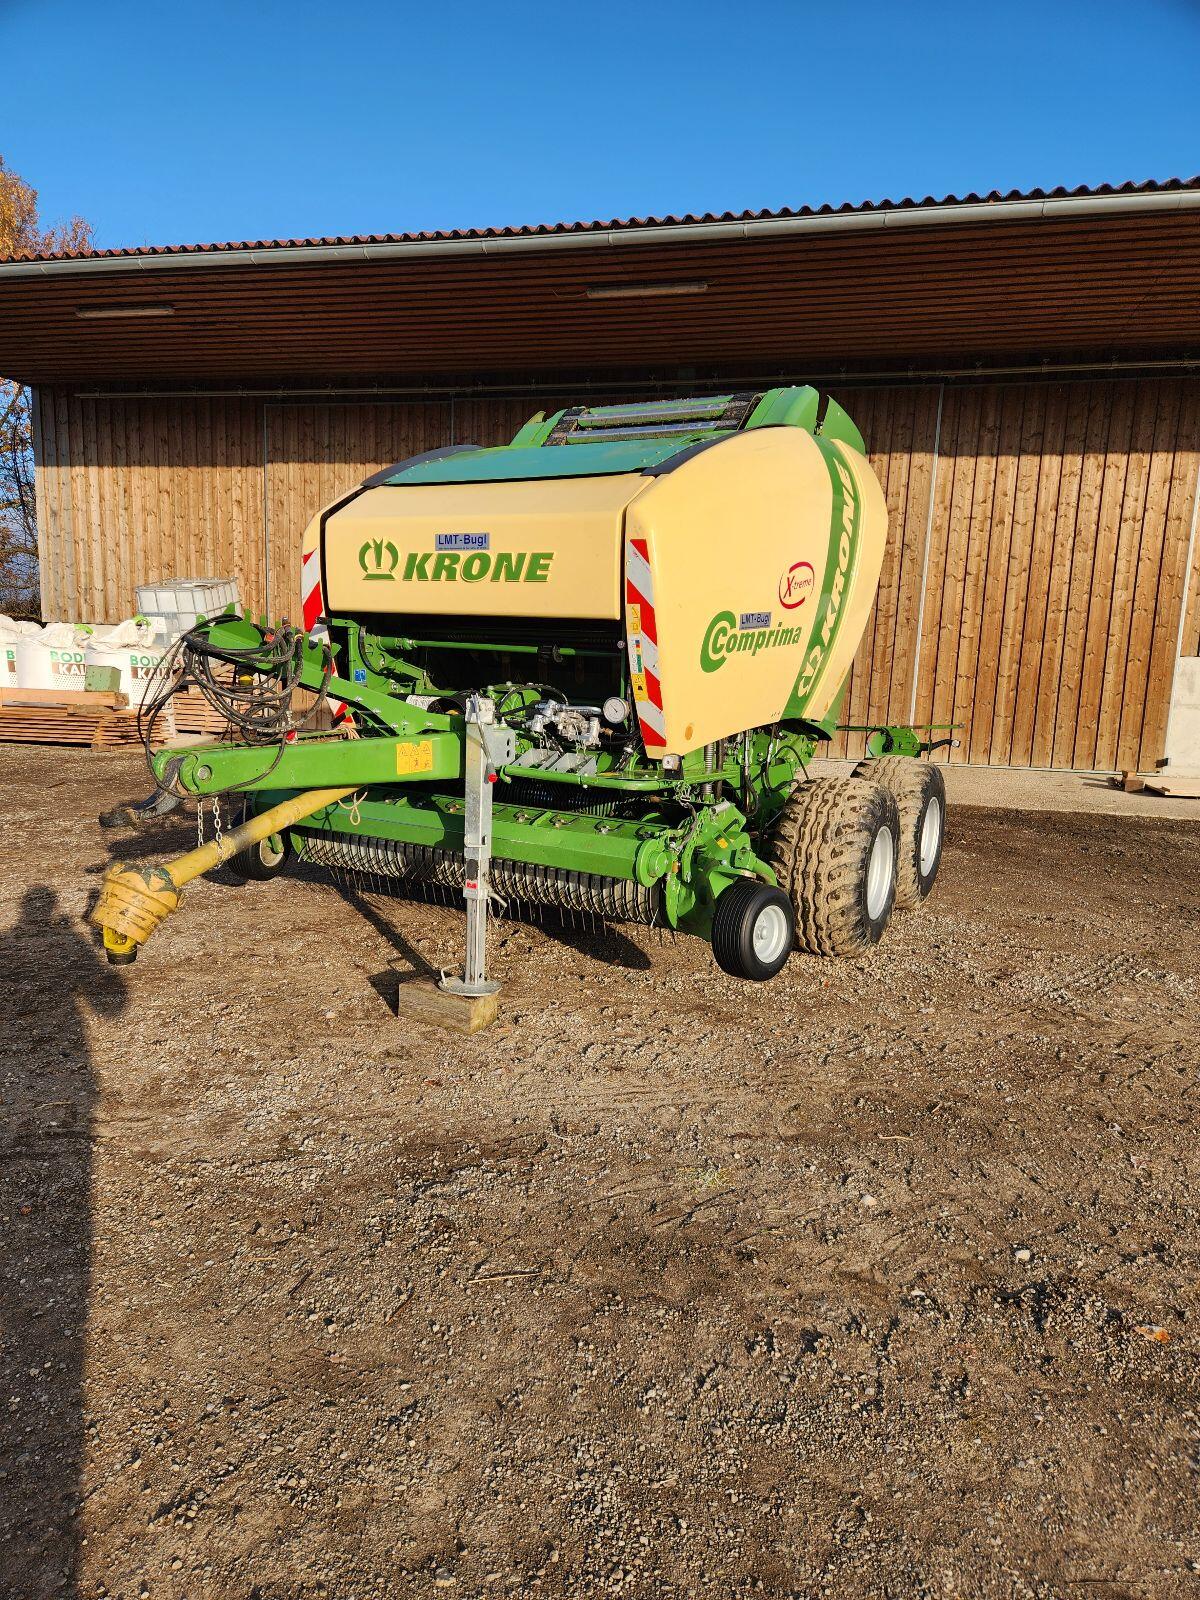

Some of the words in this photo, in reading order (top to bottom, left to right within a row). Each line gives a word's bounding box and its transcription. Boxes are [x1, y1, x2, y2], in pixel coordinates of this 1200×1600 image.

[438, 533, 487, 546] LMT-Bugl
[821, 457, 855, 644] KRONE
[402, 552, 554, 582] KRONE
[783, 575, 812, 599] X-treme
[711, 621, 803, 657] Comprima
[50, 650, 86, 663] BOD
